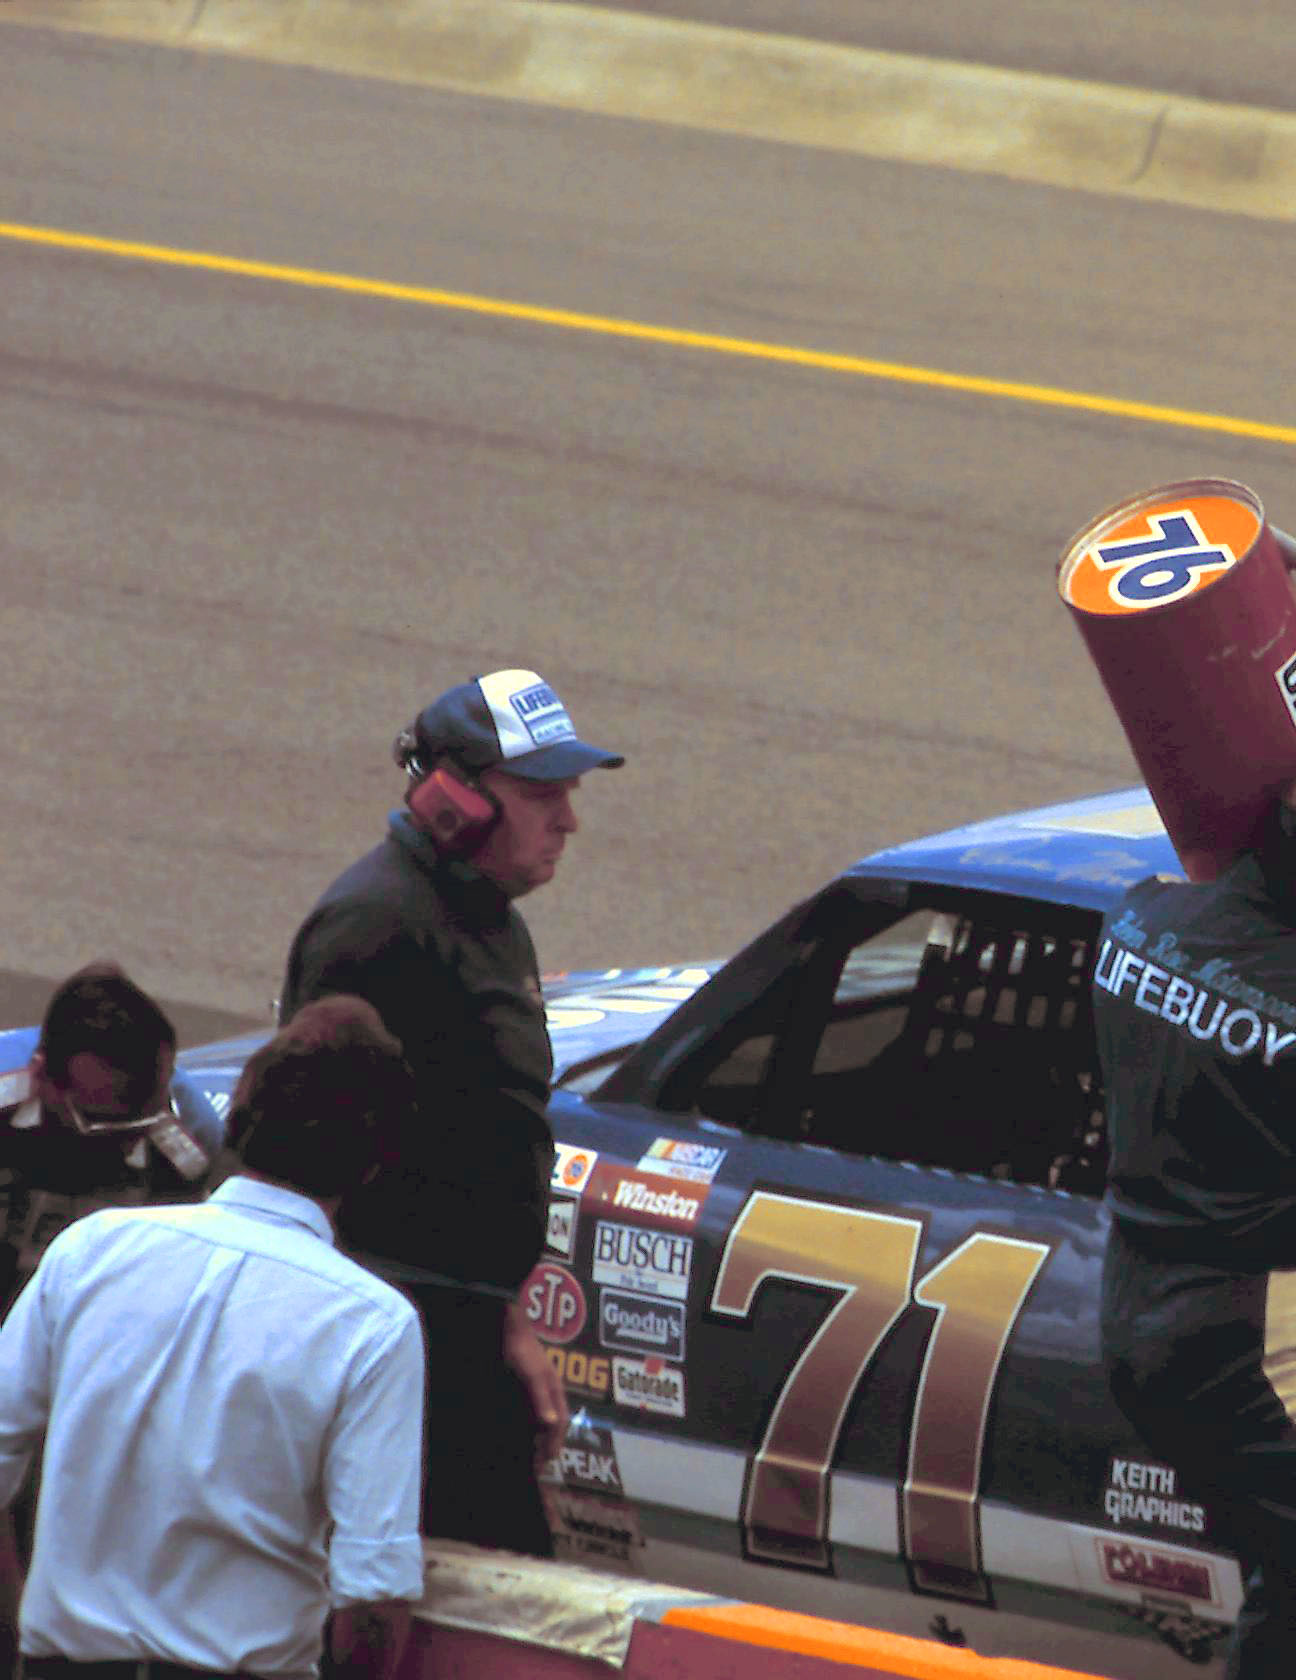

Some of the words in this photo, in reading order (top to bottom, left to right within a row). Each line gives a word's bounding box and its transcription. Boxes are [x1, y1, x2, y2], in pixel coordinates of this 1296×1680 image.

[1092, 509, 1237, 609] 76
[613, 1178, 700, 1222] Winston
[598, 1225, 690, 1276] BUSCH
[526, 1272, 577, 1329] STP
[603, 1302, 681, 1341] Goody's
[618, 1363, 681, 1402] Gatorade
[706, 1186, 1052, 1606] 71
[561, 1447, 619, 1486] PEAK
[1111, 1458, 1175, 1495] KEITH
[1103, 1489, 1206, 1533] GRAPHICS
